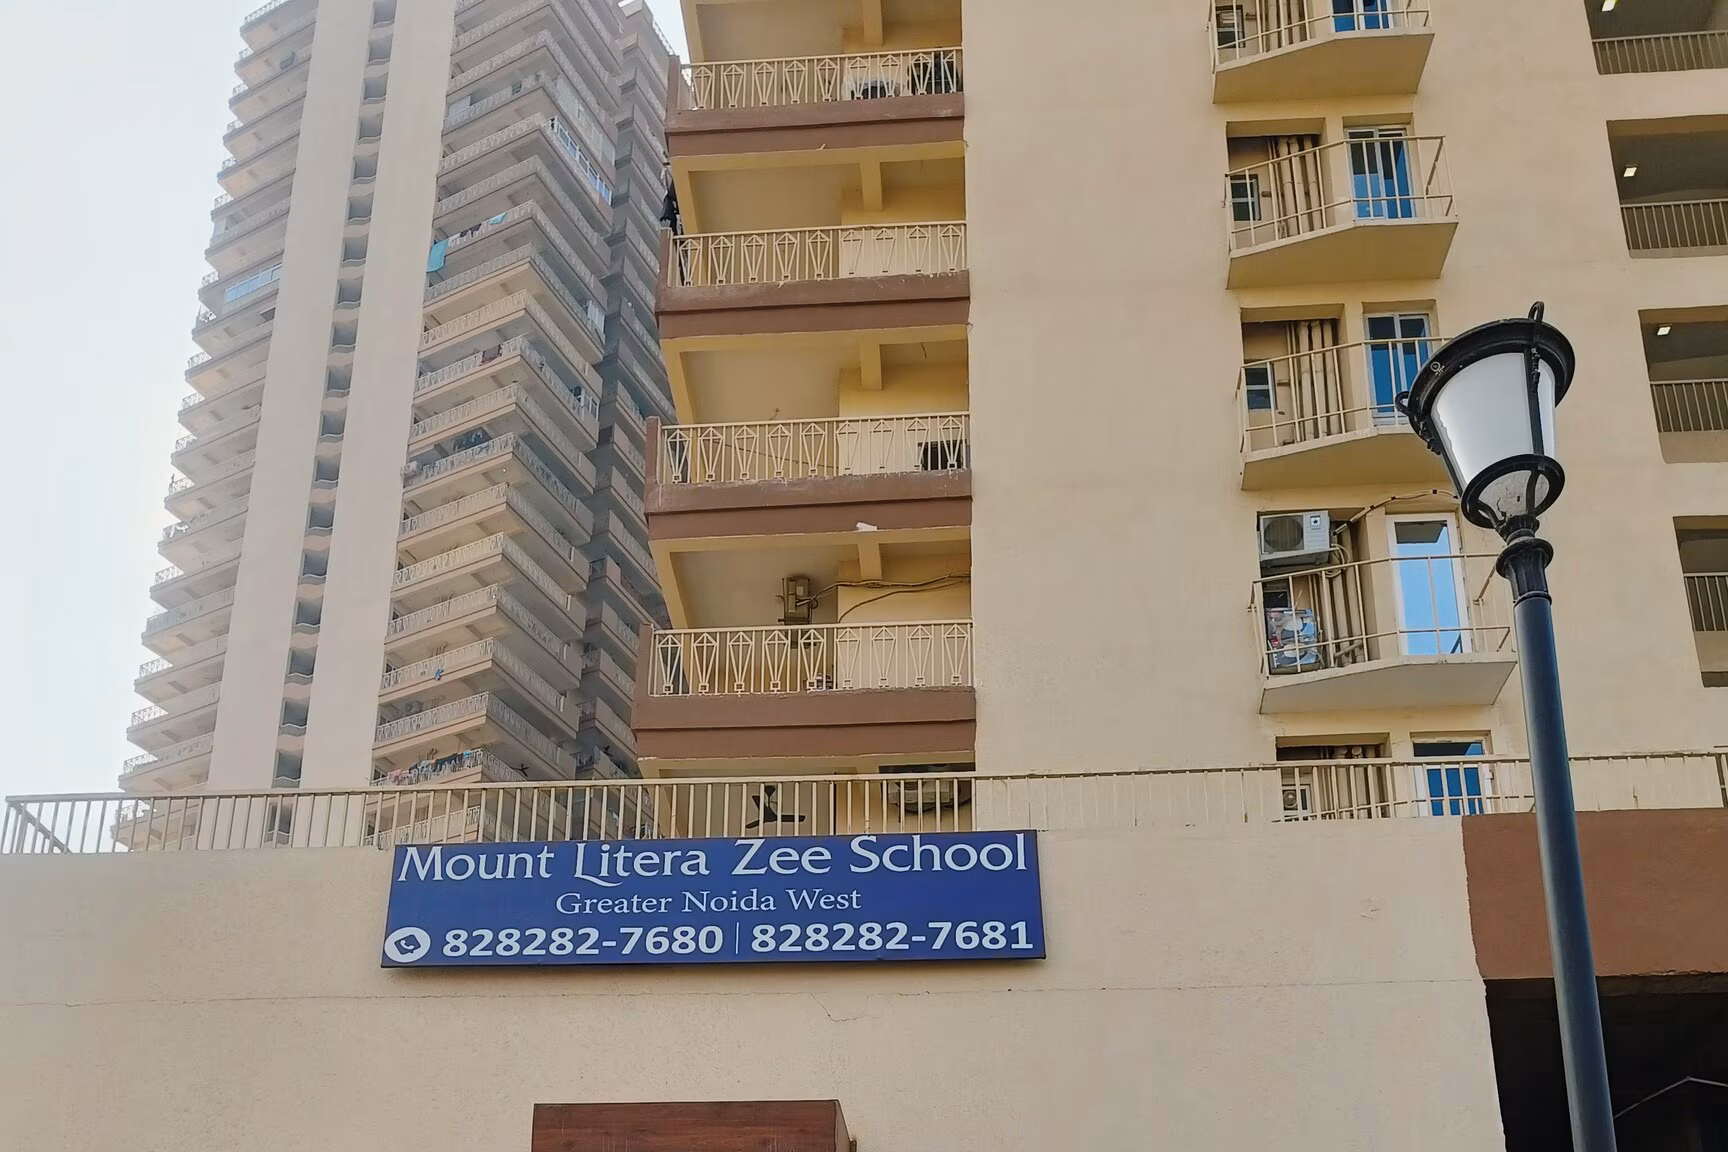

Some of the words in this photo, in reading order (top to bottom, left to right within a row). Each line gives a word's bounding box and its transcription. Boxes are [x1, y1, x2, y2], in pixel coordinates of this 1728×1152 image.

[398, 845, 554, 882] Mount
[574, 842, 710, 887] Litera
[731, 838, 832, 875] Zee
[849, 833, 1028, 873] School
[556, 893, 672, 914] Greater
[681, 889, 777, 913] Noida
[785, 888, 861, 911] West
[442, 925, 724, 957] 828282-7680
[751, 920, 1034, 952] 828282-7681
